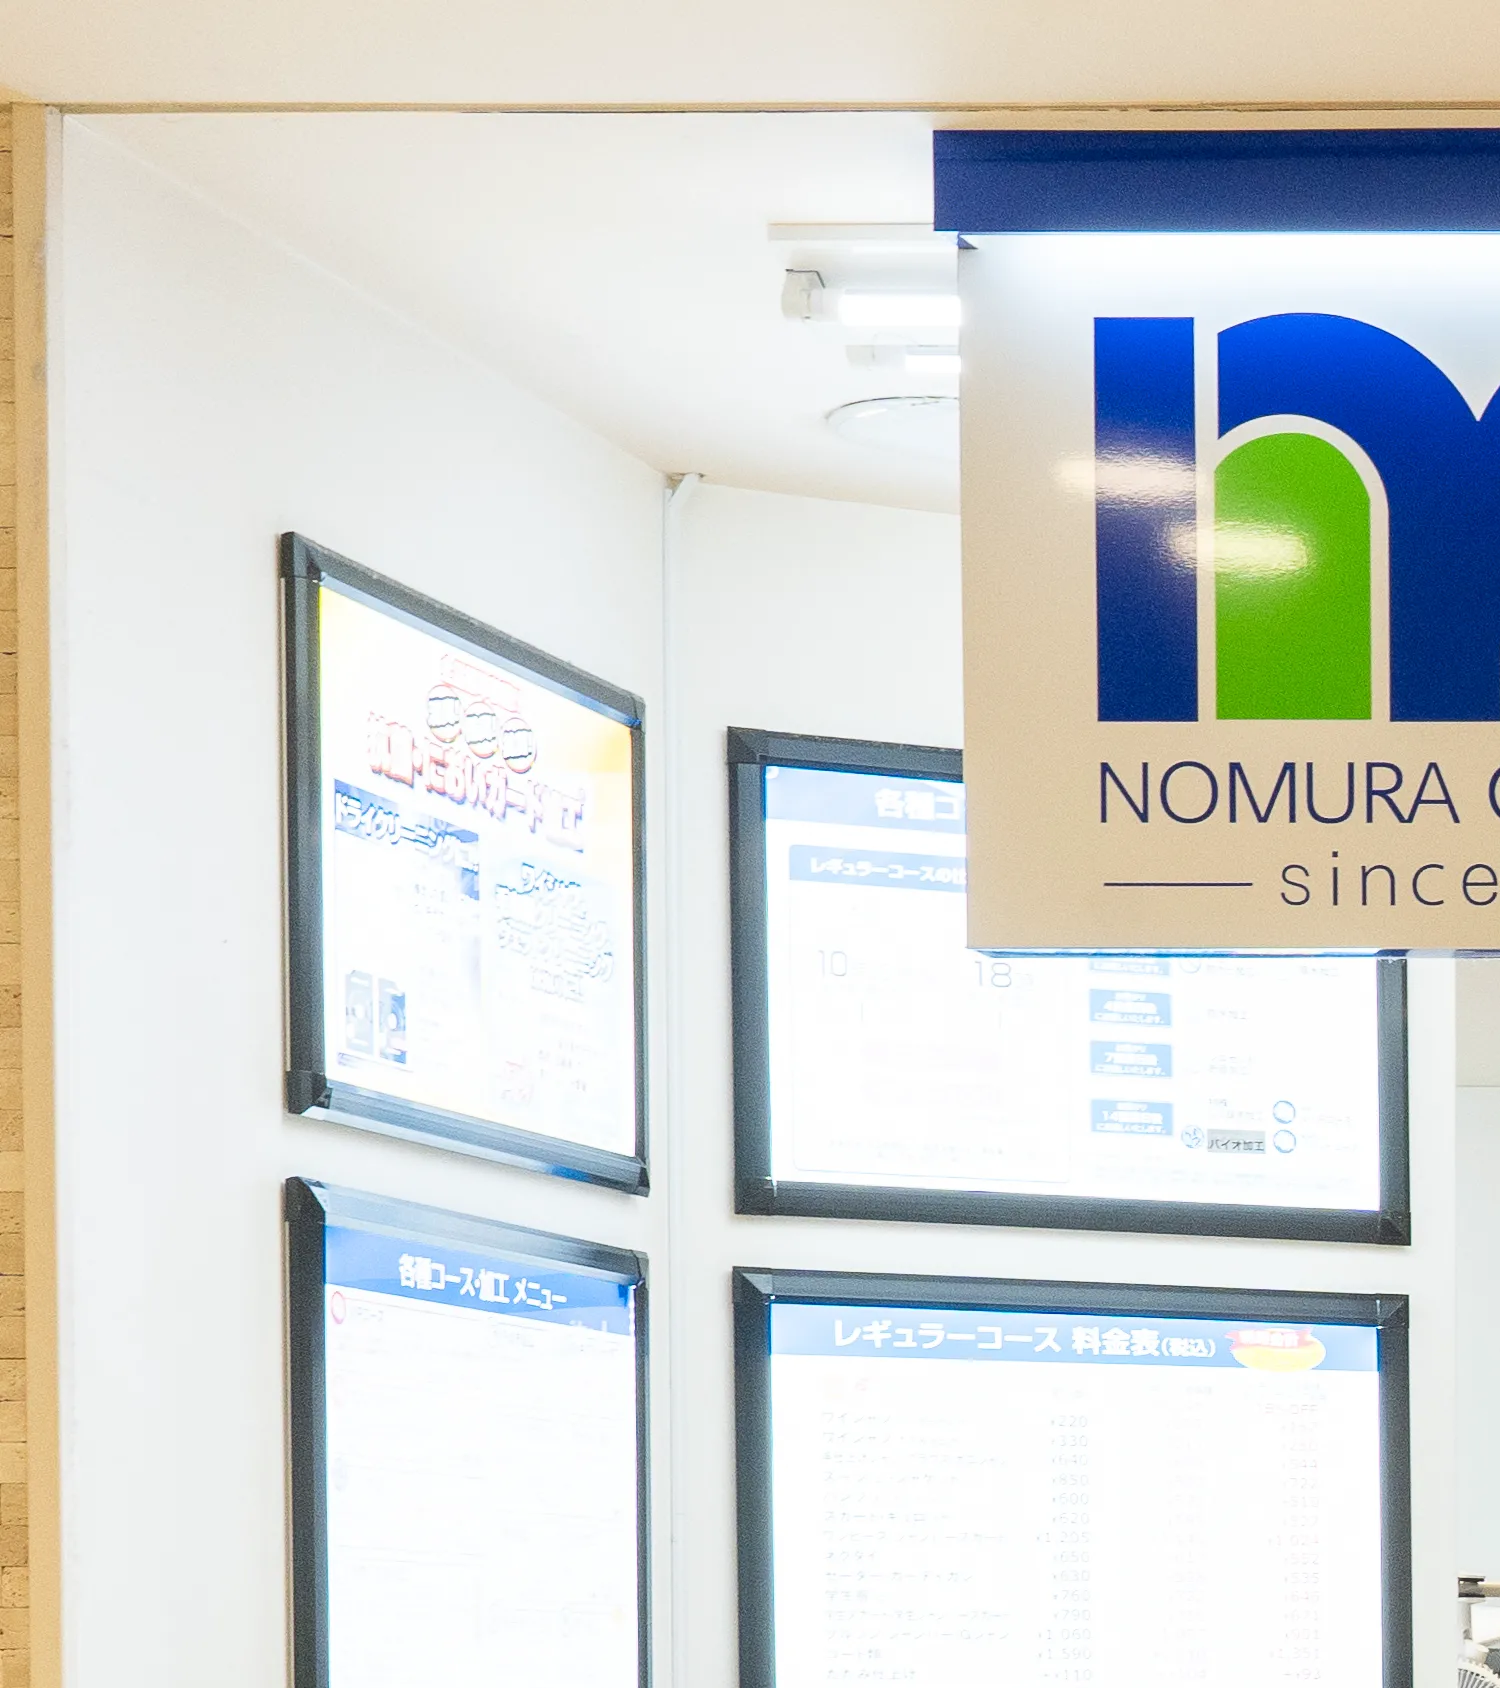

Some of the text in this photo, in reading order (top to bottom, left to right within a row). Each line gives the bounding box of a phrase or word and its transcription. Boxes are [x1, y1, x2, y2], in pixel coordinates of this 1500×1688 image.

[1099, 761, 1460, 826] NOMURA
[834, 1319, 1062, 1354] レギュラーコース
